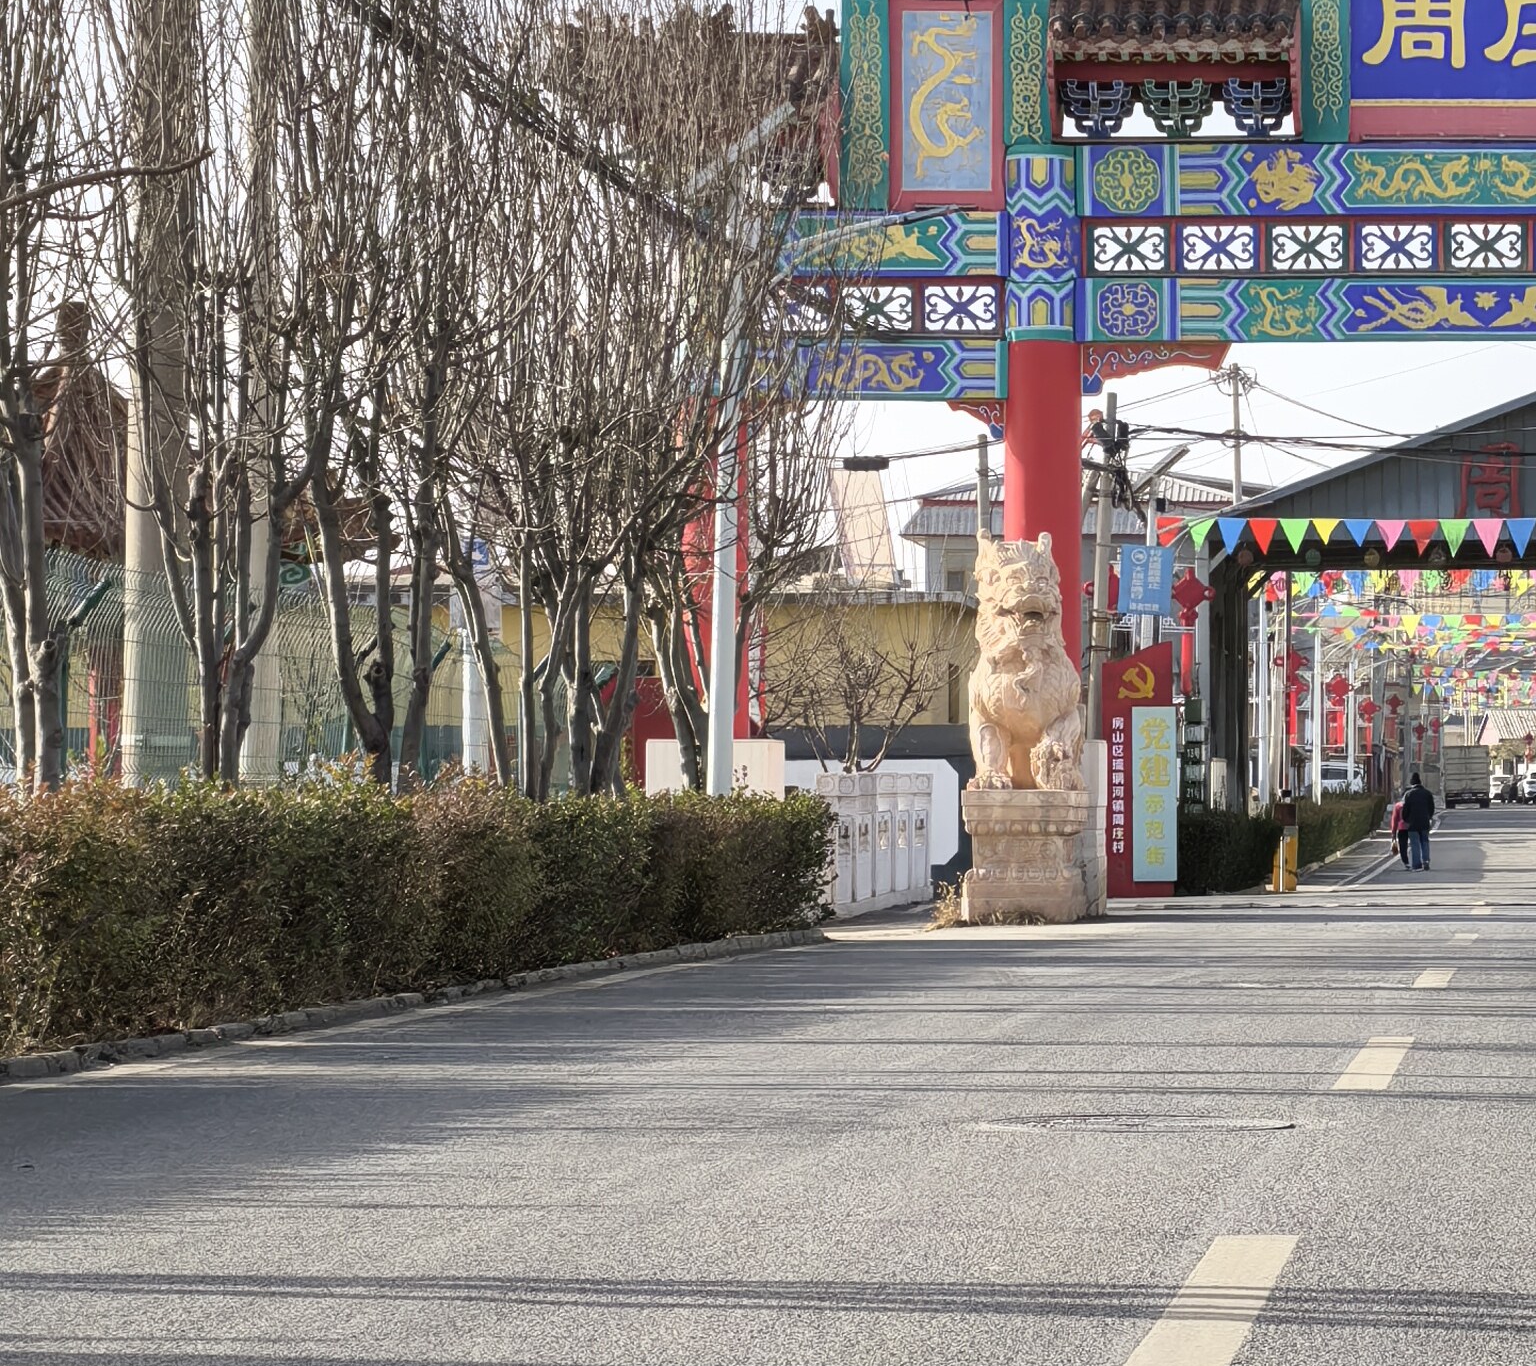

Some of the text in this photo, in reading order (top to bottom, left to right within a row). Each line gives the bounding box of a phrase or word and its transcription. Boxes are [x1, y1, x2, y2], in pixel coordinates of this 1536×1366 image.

[1112, 717, 1124, 853] 房山区琉璃河镇周庄村
[1138, 717, 1171, 866] 党建示范街
